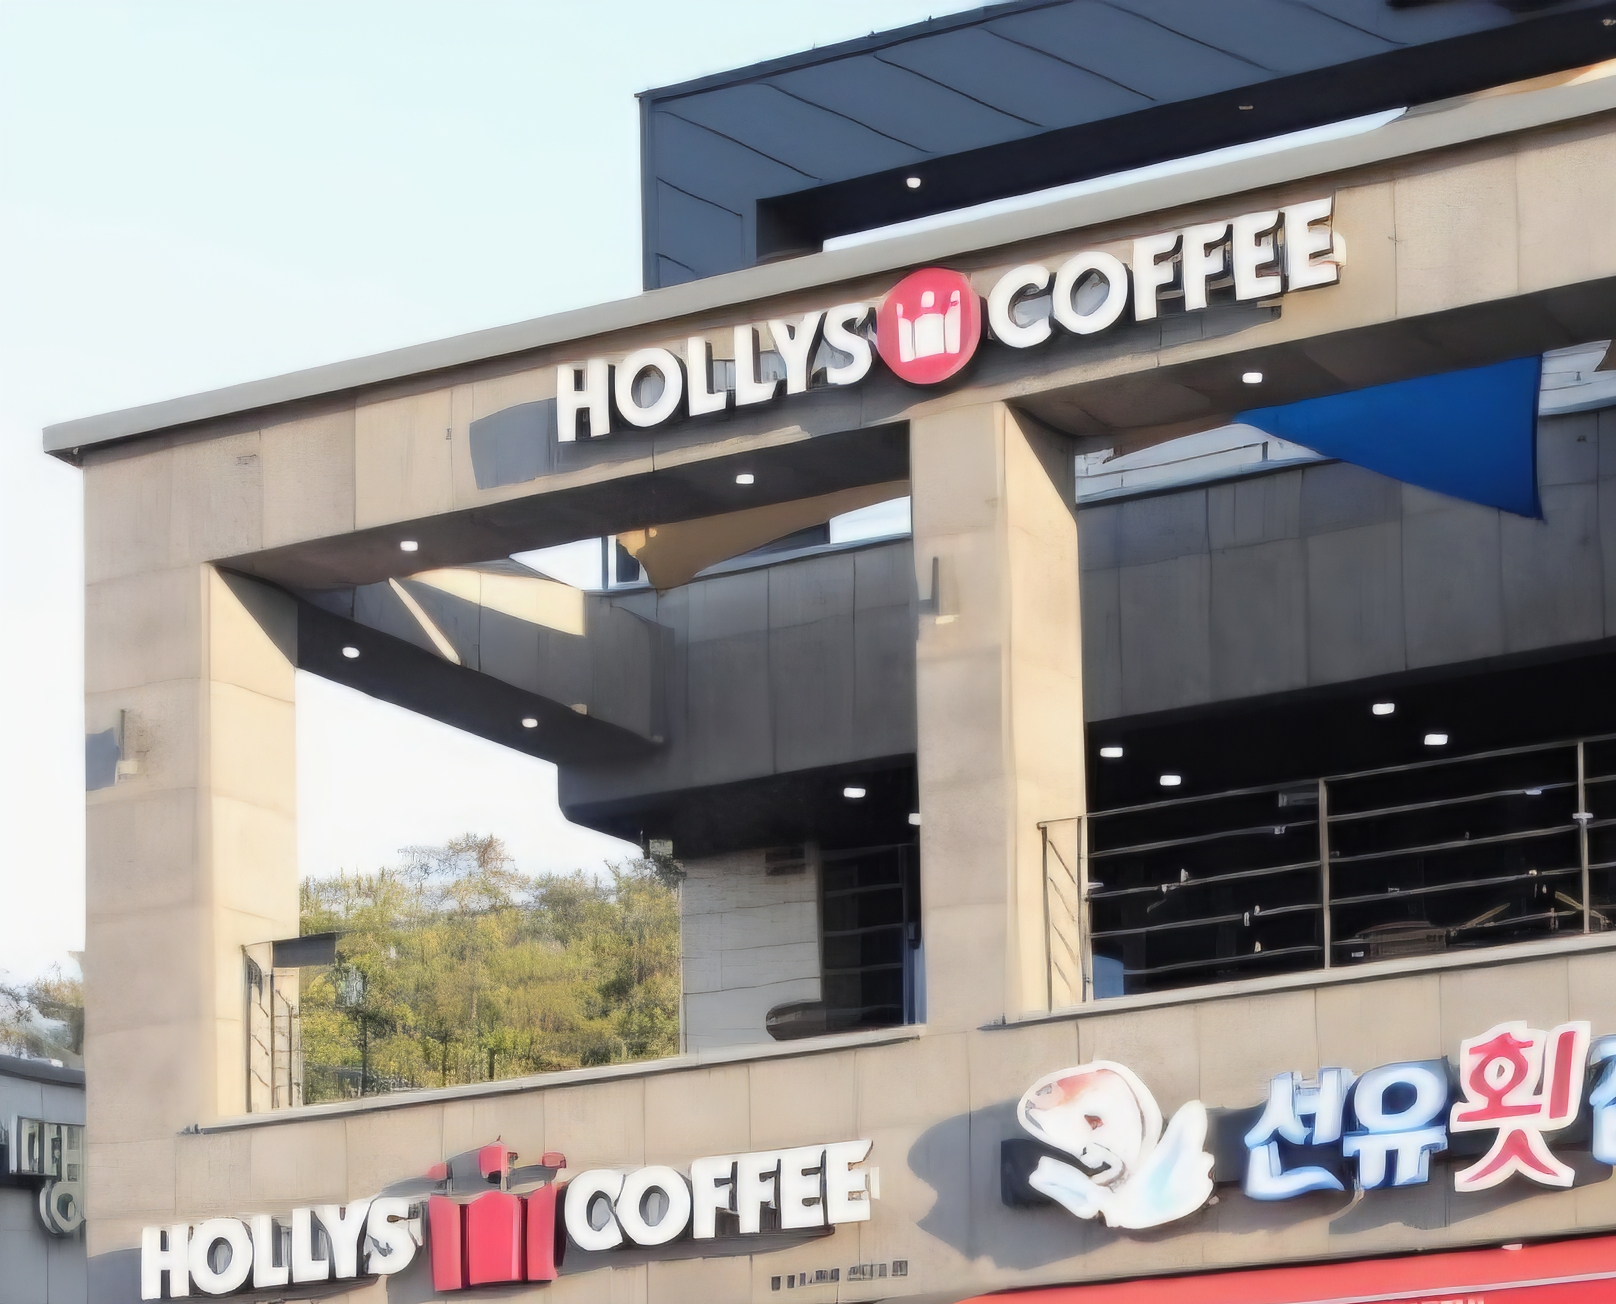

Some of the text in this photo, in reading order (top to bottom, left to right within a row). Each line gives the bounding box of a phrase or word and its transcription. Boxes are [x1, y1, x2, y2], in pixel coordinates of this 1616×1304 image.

[556, 197, 1341, 442] HOLLYS COFFEE
[140, 1139, 873, 1301] HOLLYS COFFEE
